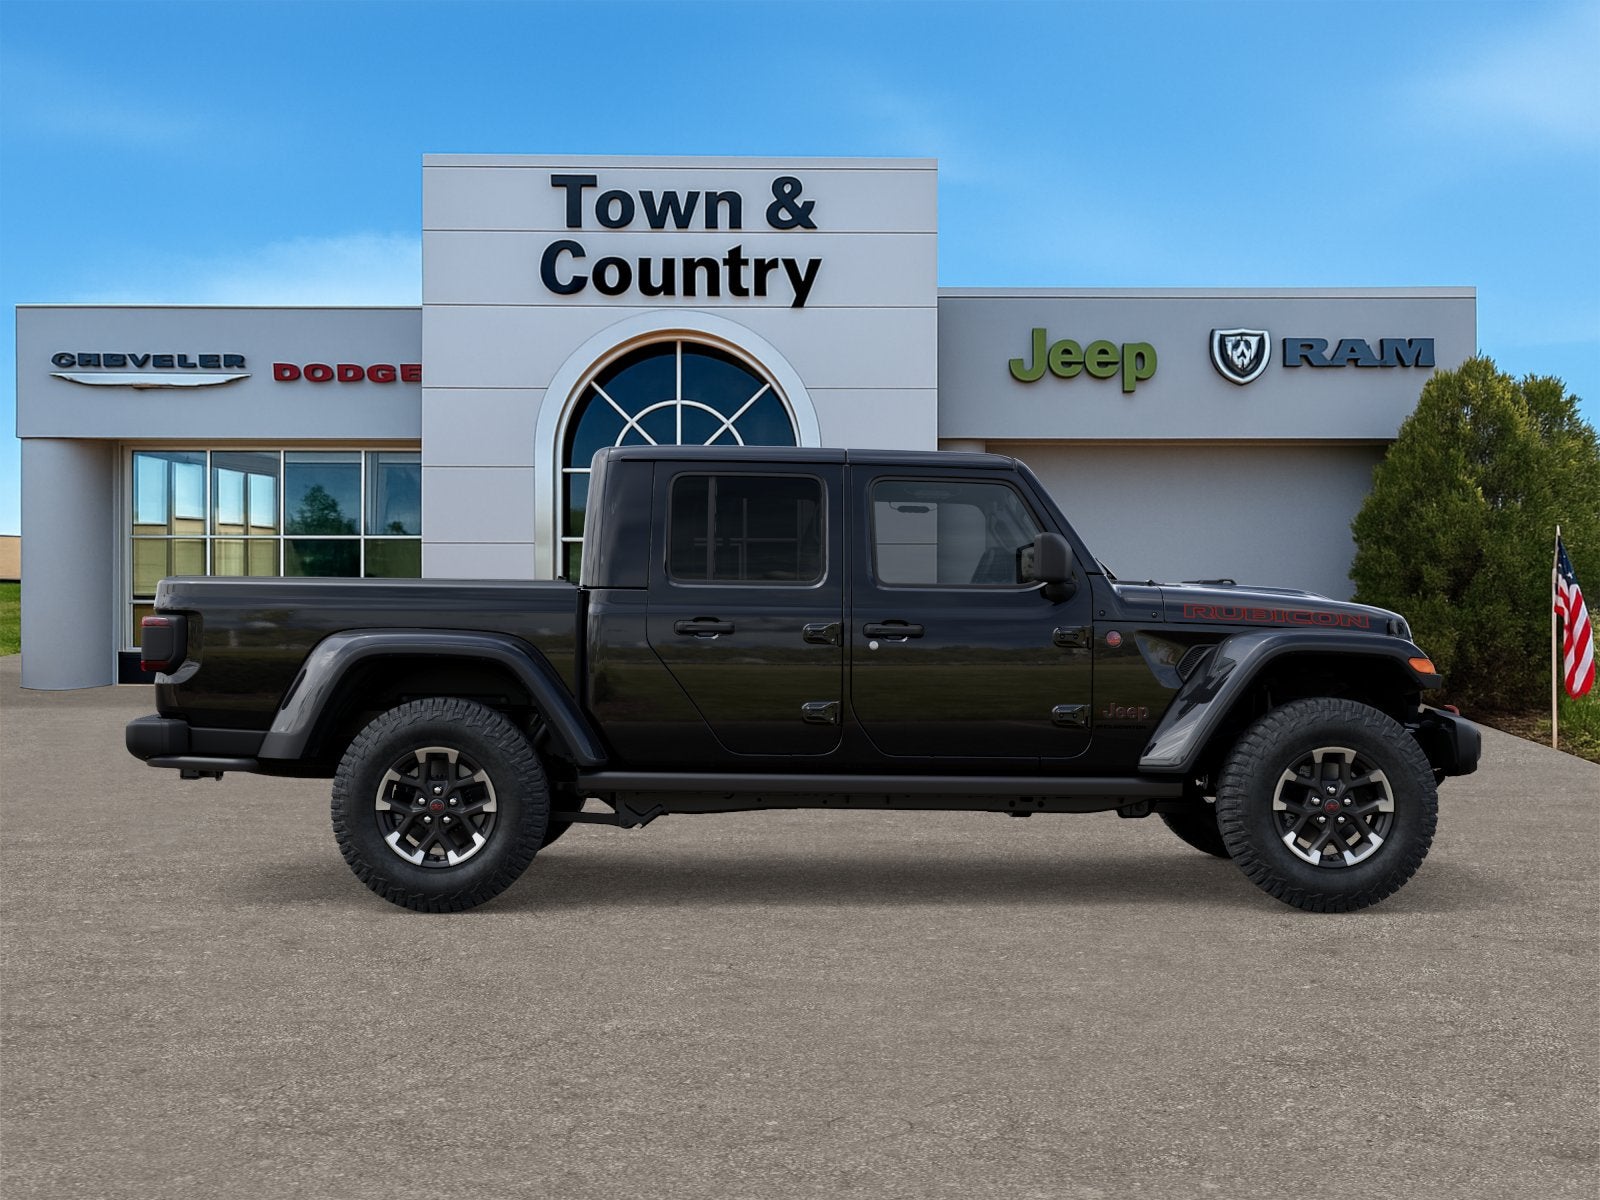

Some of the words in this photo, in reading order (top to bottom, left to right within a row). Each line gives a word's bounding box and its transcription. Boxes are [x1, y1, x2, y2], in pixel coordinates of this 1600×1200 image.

[550, 174, 743, 229] Town
[765, 176, 818, 230] &
[540, 239, 822, 308] Country
[1008, 328, 1157, 393] Jeep
[1282, 337, 1436, 368] RAM
[272, 362, 422, 384] DODGE
[1183, 603, 1370, 628] RUBICON
[1102, 702, 1150, 720] Jeep
